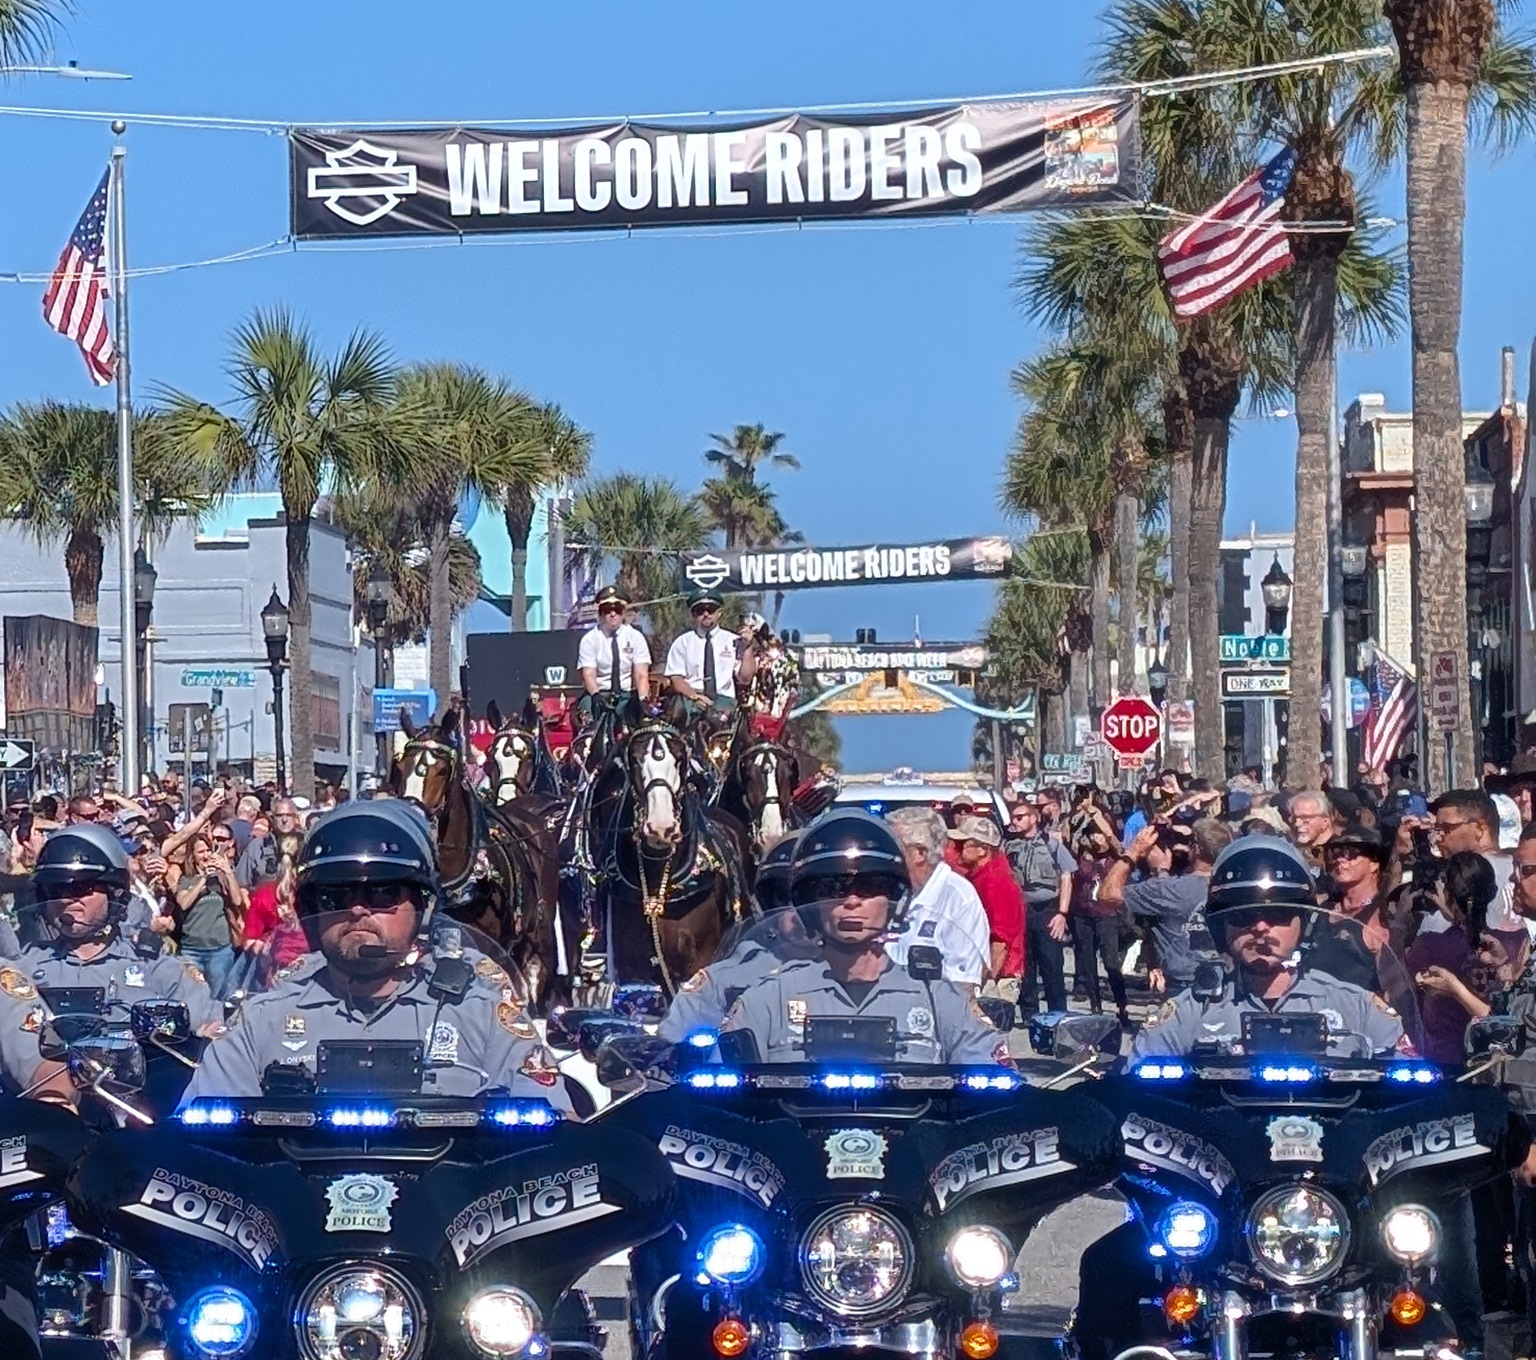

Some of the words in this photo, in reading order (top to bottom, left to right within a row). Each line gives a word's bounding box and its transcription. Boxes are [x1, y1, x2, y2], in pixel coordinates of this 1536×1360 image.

[445, 132, 748, 216] WELCOME
[766, 123, 982, 204] RIDERS
[740, 550, 859, 585] WELCOME
[864, 546, 951, 578] RIDERS
[1106, 715, 1158, 738] STOP
[153, 1167, 244, 1210] DAYTONA
[658, 1134, 780, 1207] POLICE
[934, 1138, 1060, 1211] POLICE
[1366, 1123, 1476, 1186] POLICE
[140, 1179, 272, 1270] POLICE
[333, 1216, 385, 1227] POLICE
[445, 1186, 518, 1238] DAYTONA
[523, 1163, 598, 1193] BEACH
[451, 1175, 601, 1266] POLICE
